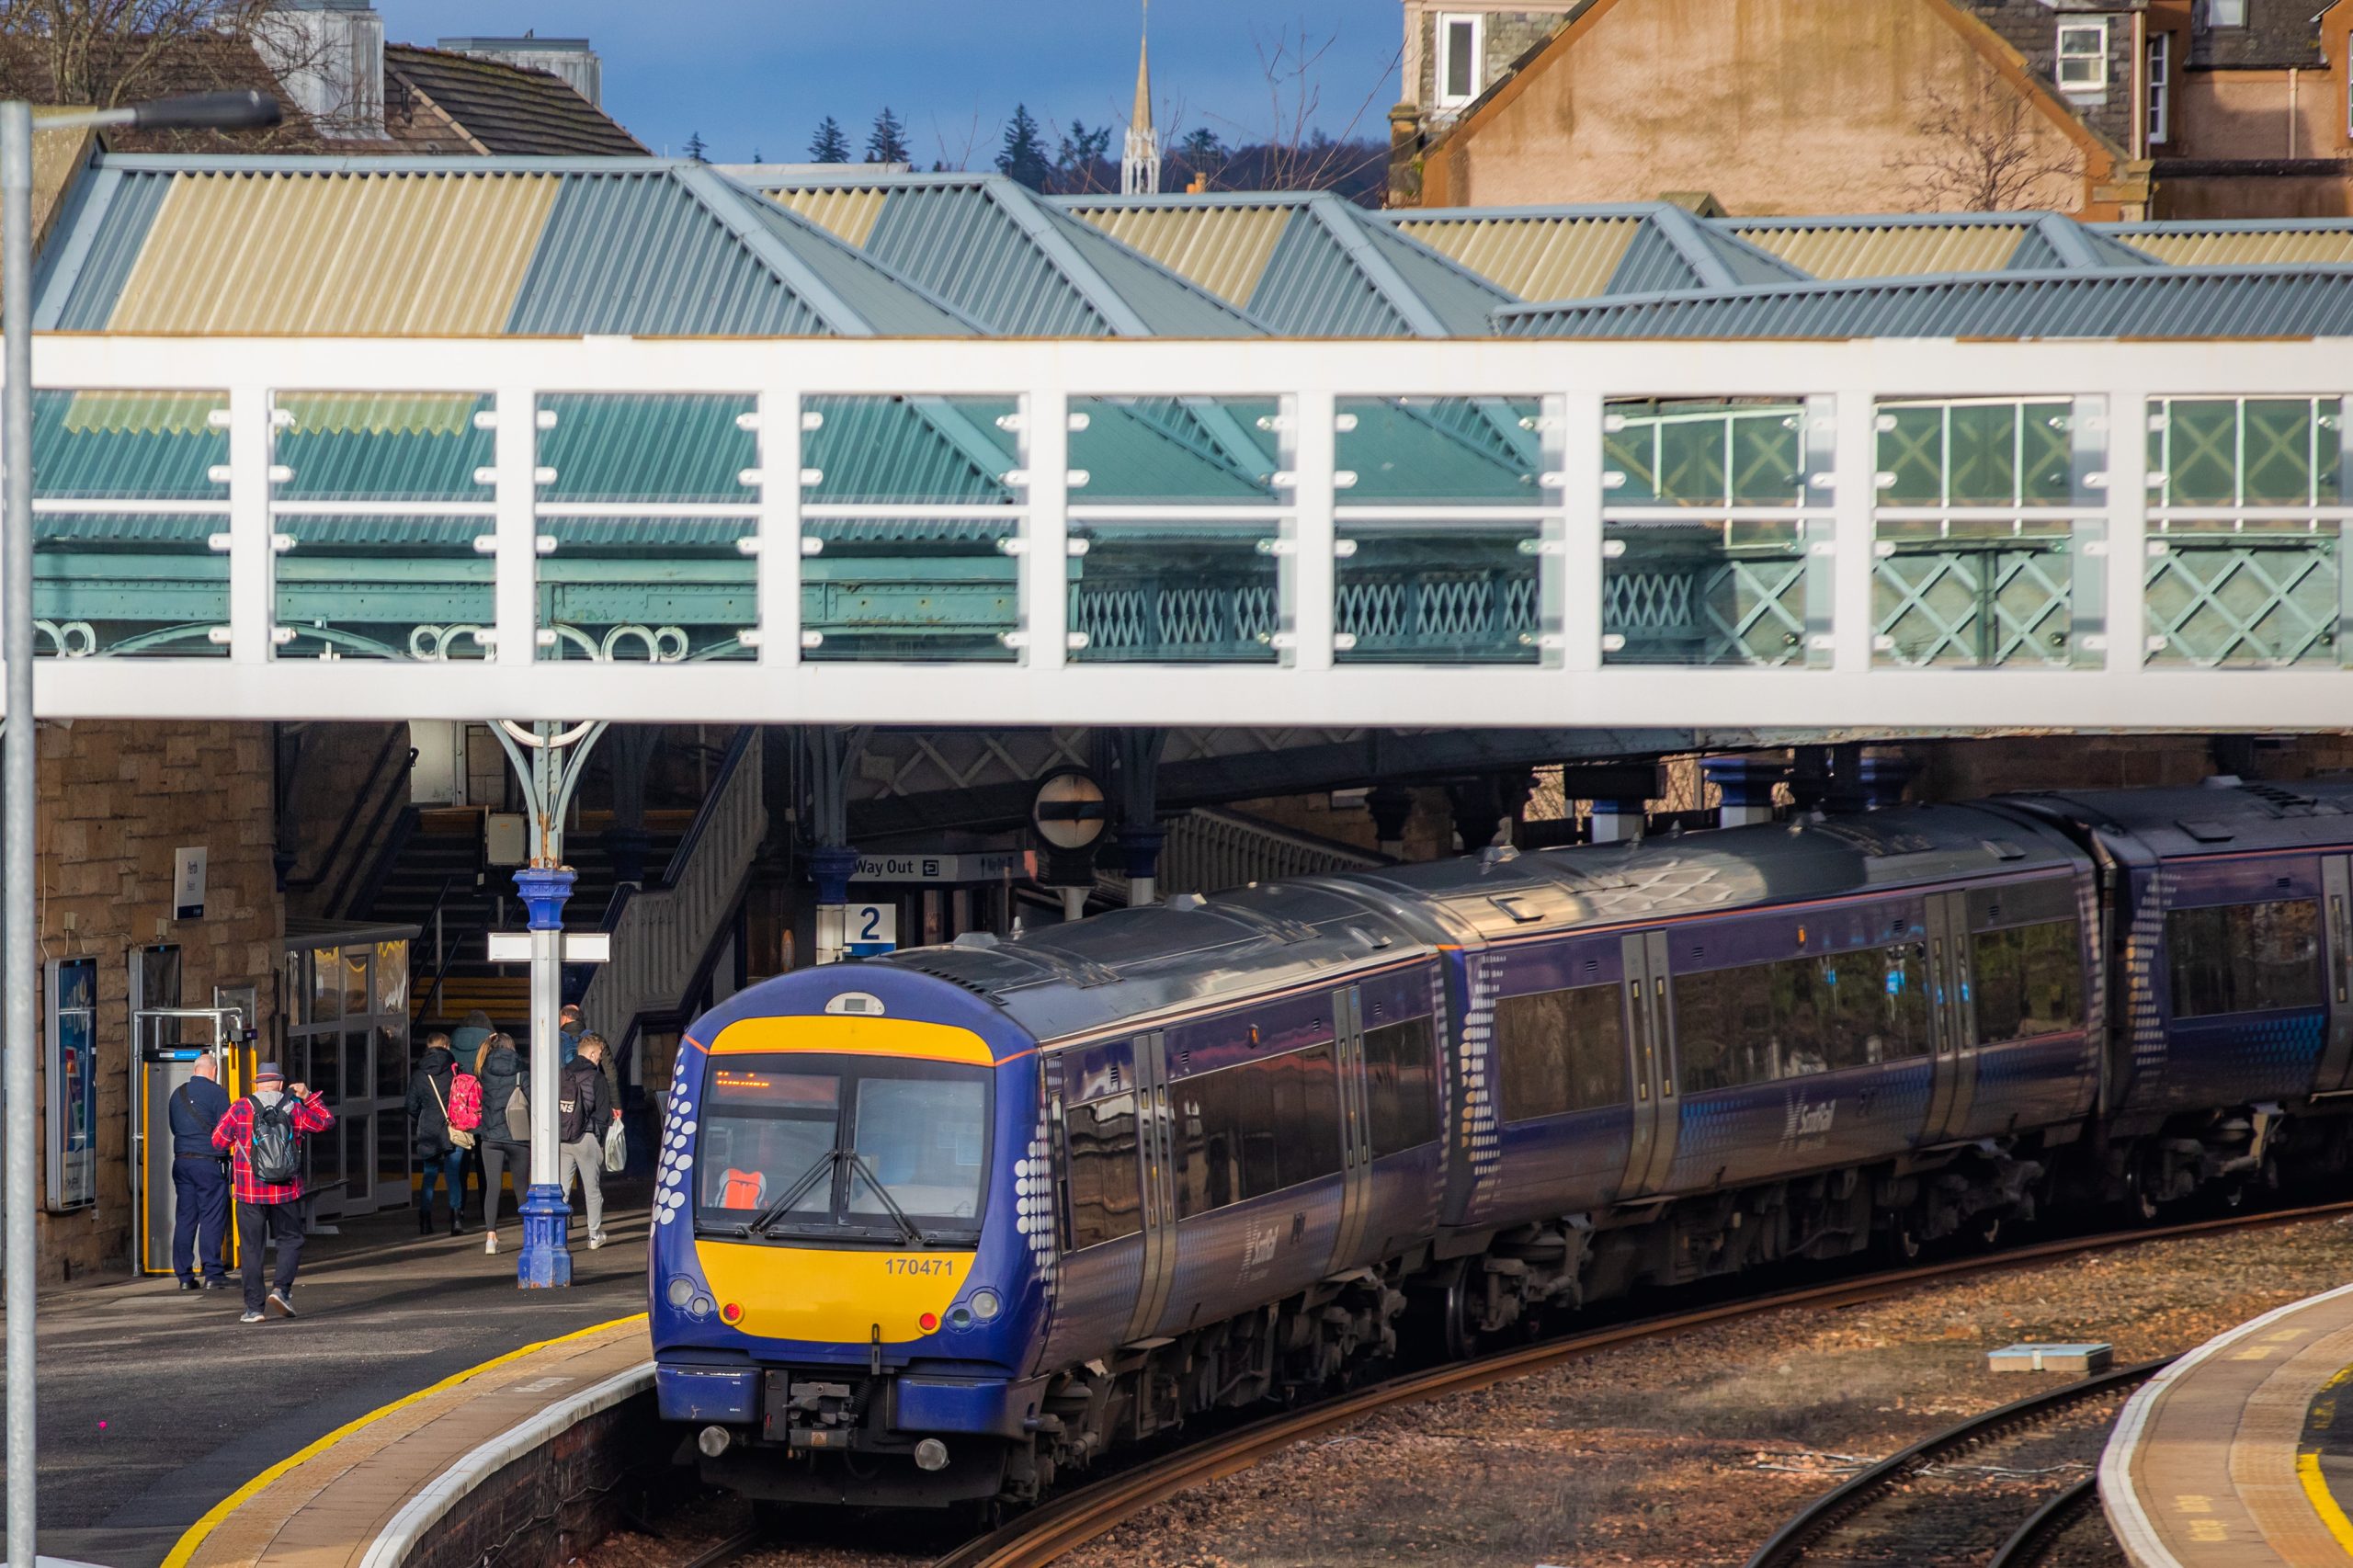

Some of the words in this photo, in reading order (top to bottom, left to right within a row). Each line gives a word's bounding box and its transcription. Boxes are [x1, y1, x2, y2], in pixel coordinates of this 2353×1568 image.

[855, 859, 883, 877] Way
[887, 859, 914, 873] Out
[860, 906, 881, 940] 2
[560, 1099, 575, 1113] NS
[885, 1258, 953, 1276] 170471
